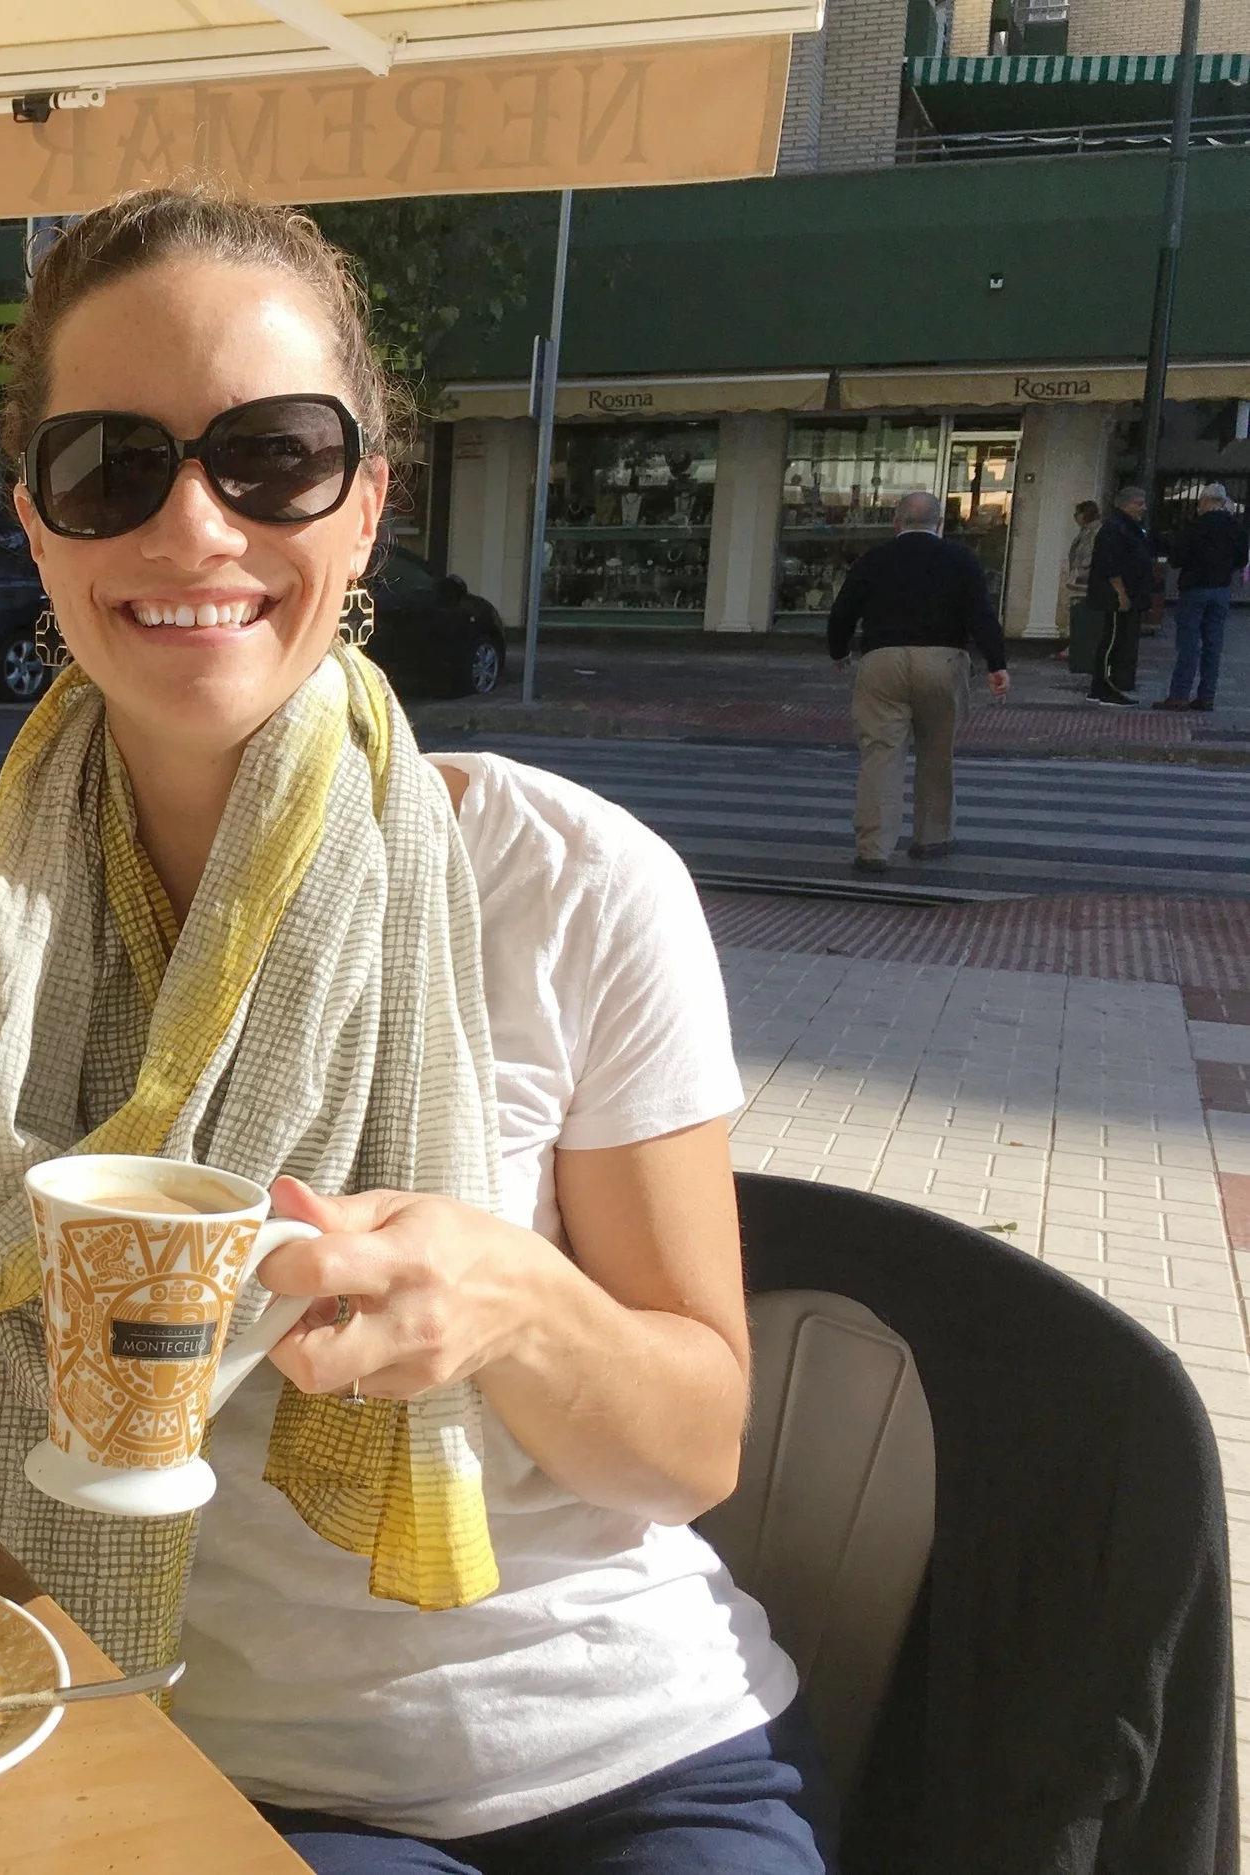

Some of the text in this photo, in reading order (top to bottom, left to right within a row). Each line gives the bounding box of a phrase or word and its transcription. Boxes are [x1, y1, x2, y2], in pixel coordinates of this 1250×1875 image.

[1013, 377, 1091, 400] Rosma
[588, 390, 653, 412] Rosma
[122, 1339, 207, 1353] MONTECELIO
